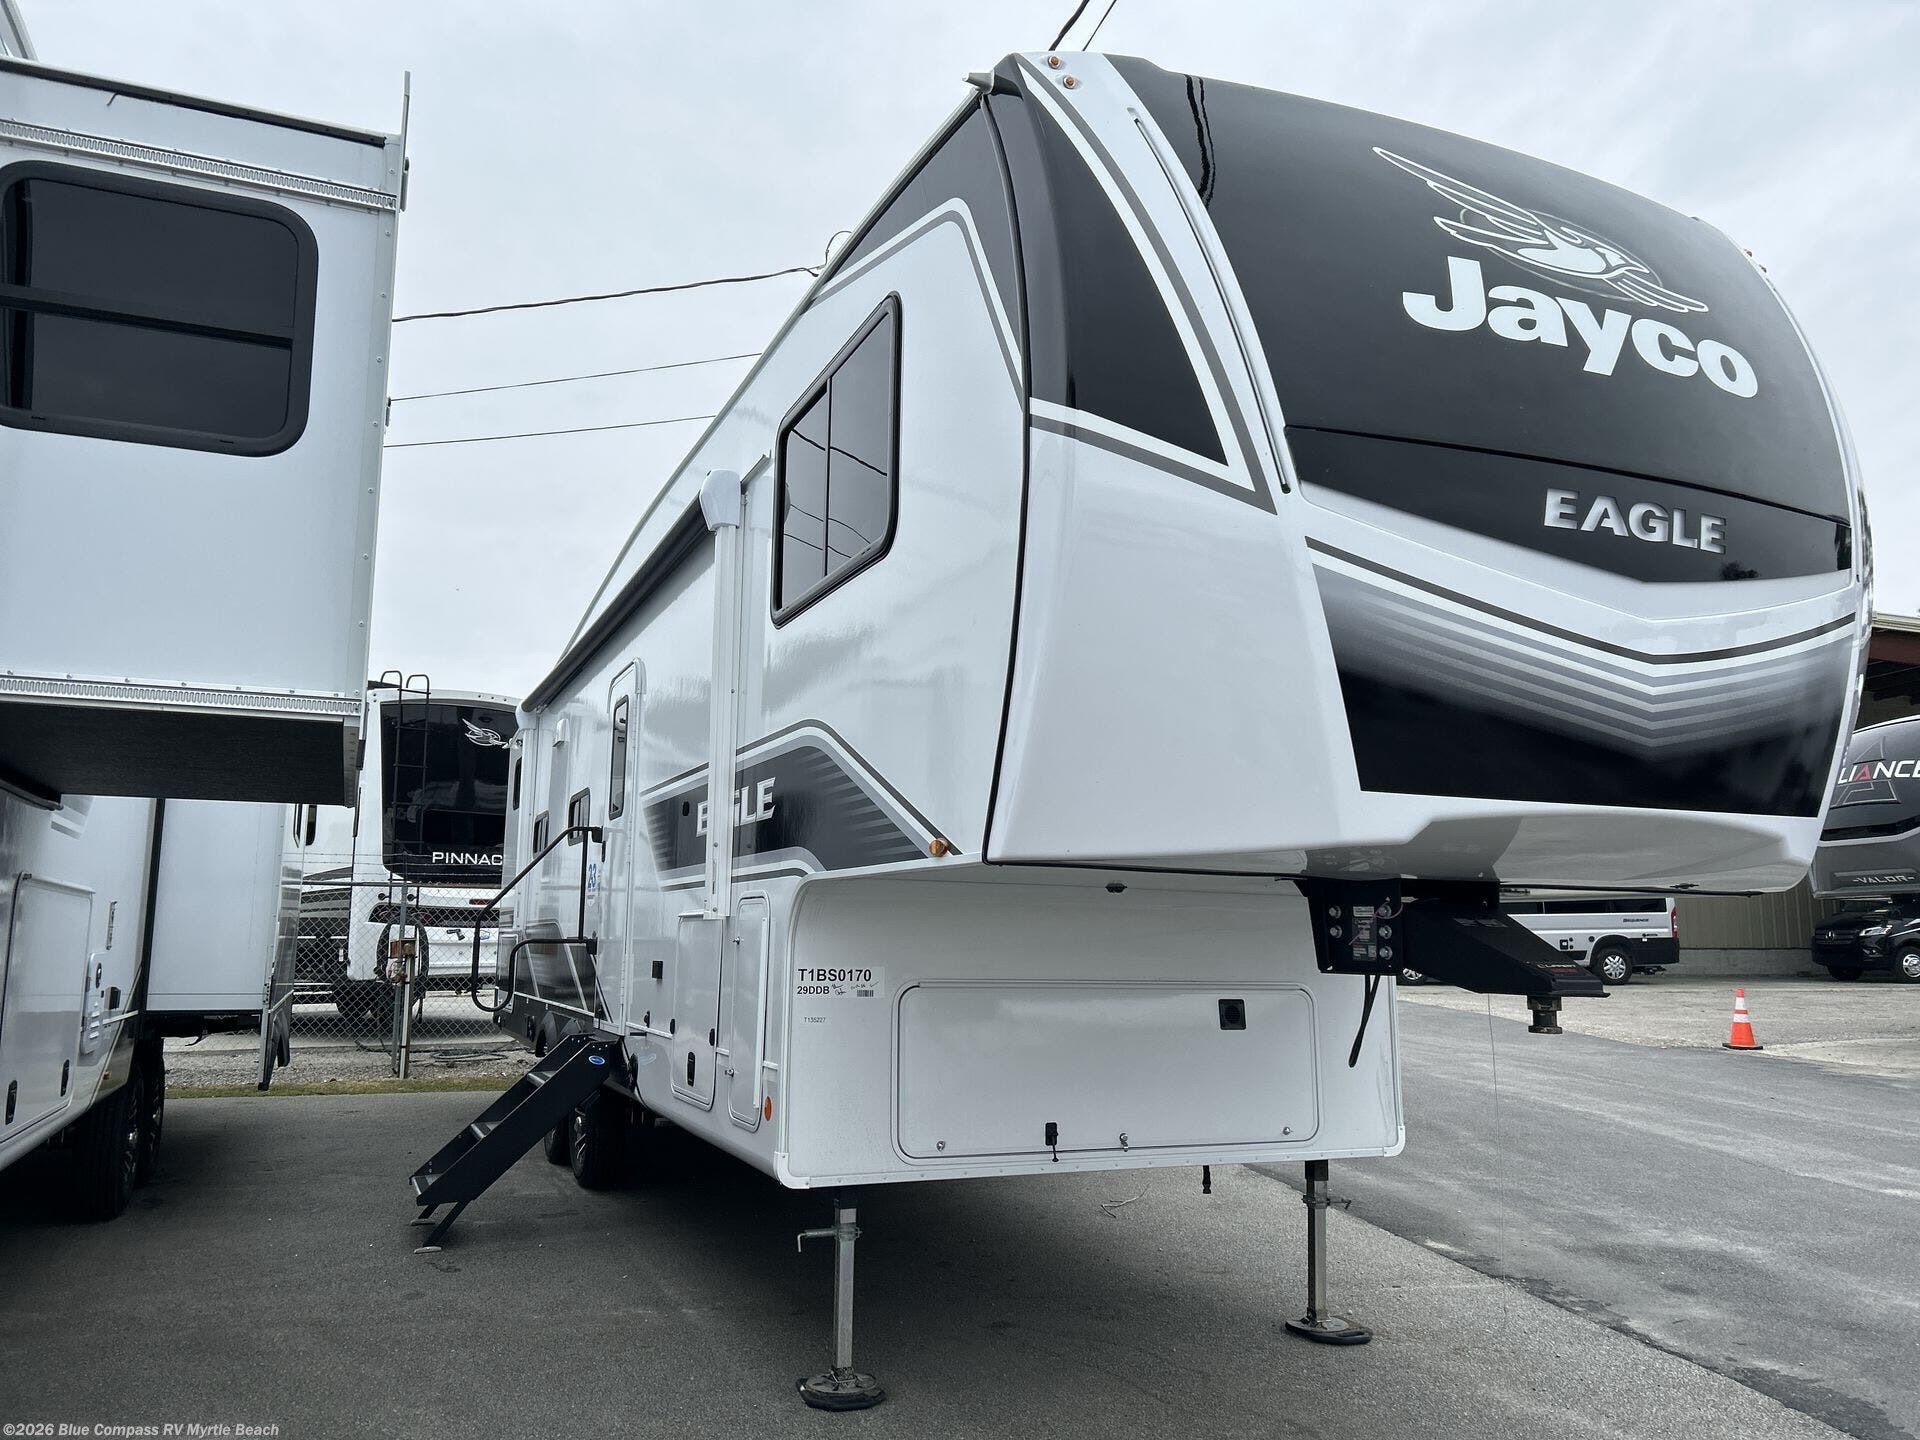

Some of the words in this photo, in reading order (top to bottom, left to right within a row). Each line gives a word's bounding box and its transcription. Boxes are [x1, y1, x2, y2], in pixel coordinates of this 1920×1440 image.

[1401, 256, 1758, 399] Jayco
[1543, 488, 1727, 555] EAGLE
[696, 777, 776, 838] ELE
[797, 968, 872, 982] T1BS0170
[797, 985, 830, 995] 29DDB
